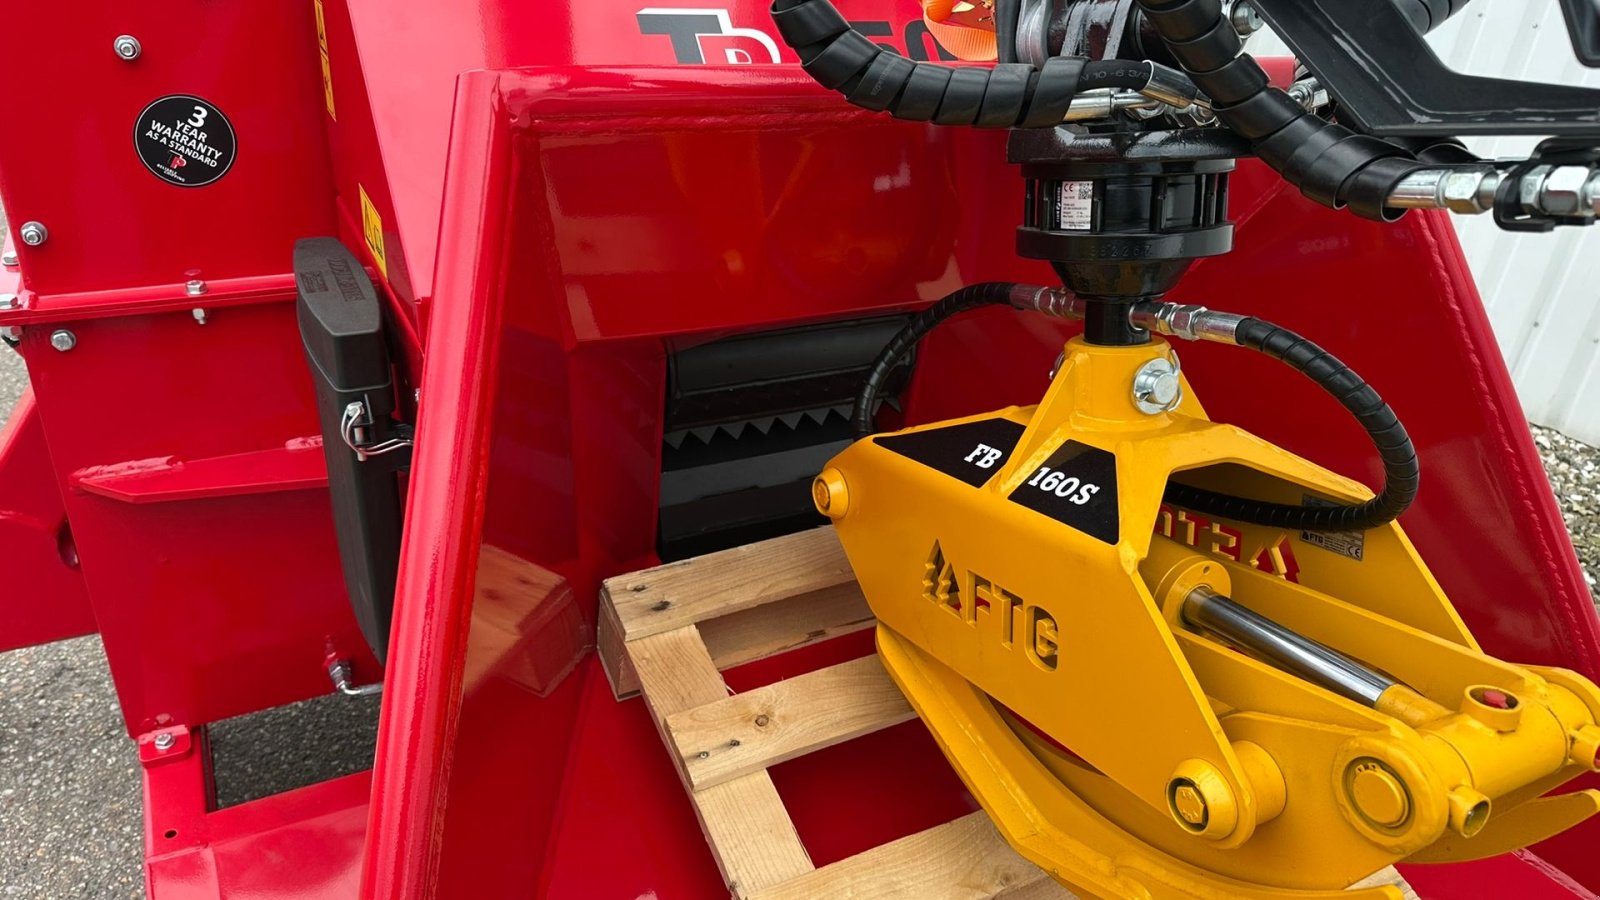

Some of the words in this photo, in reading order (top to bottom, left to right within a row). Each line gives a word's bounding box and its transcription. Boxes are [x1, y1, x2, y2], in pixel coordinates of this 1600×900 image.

[175, 119, 208, 143] YEAR
[187, 105, 208, 128] 3
[145, 130, 160, 140] AS
[159, 136, 167, 145] A
[168, 140, 218, 168] STANDARD
[151, 119, 223, 160] WARRANTY
[963, 443, 1003, 469] FB
[1027, 466, 1101, 505] 160S
[965, 569, 1059, 672] FTG
